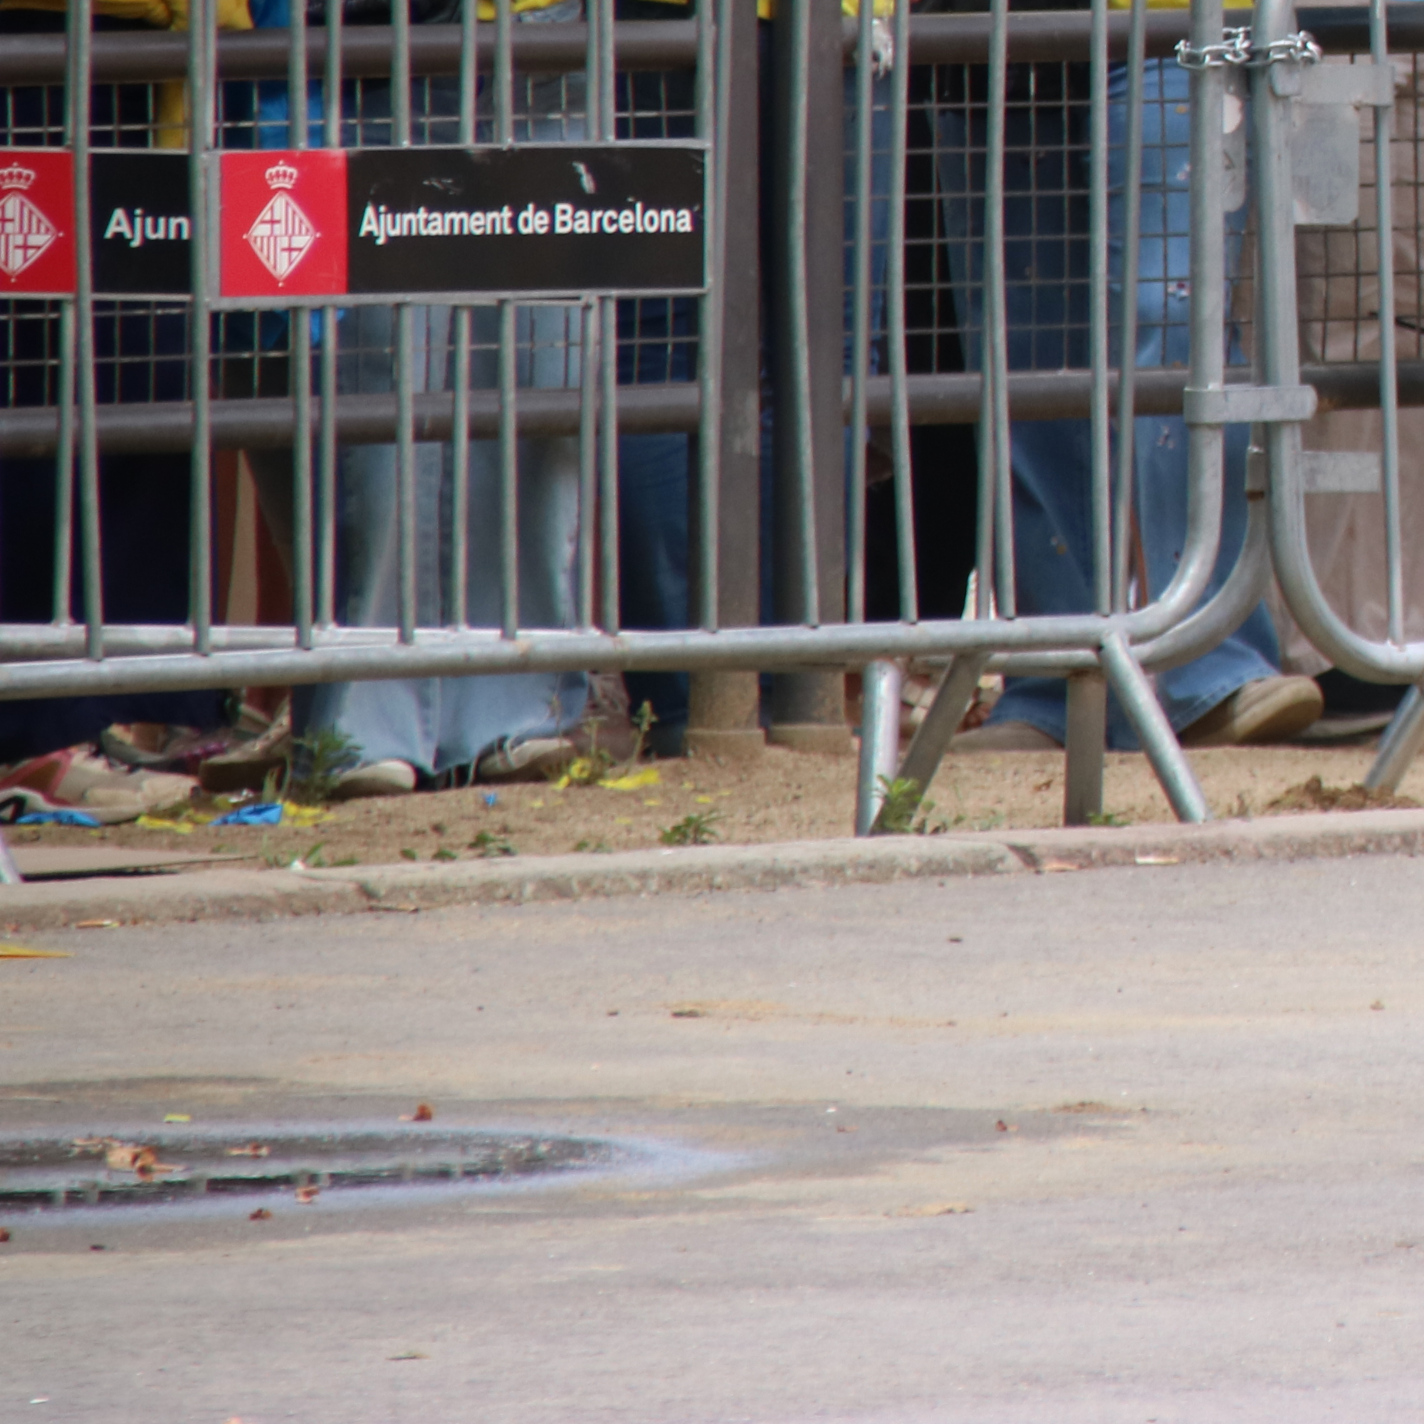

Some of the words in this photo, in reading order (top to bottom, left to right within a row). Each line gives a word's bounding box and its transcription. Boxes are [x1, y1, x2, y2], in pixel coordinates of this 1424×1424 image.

[358, 201, 514, 246] Ajuntament
[517, 202, 549, 235] de
[553, 201, 693, 235] Barcelona
